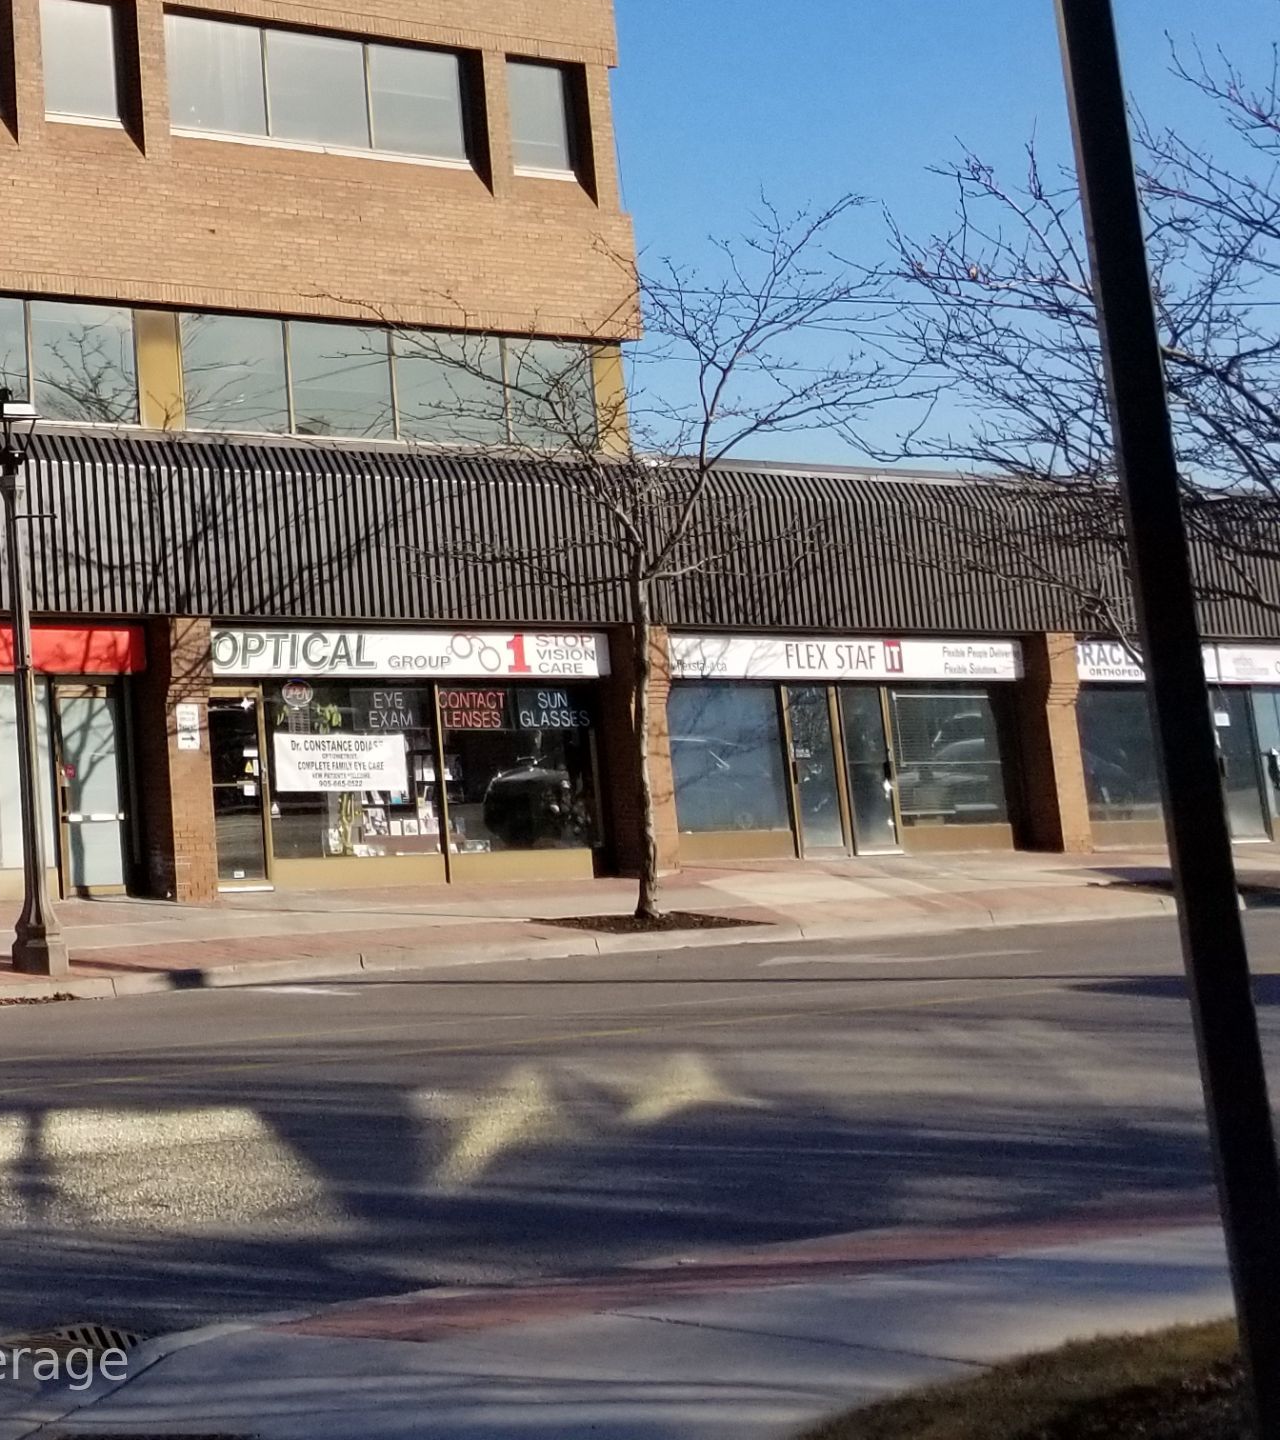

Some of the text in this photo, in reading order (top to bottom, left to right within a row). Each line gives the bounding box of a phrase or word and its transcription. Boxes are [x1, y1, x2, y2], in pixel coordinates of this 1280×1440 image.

[536, 634, 593, 647] STOP
[212, 631, 451, 670] OPTICAL GROUP
[506, 634, 532, 672] 1
[536, 649, 596, 661] VISION
[785, 643, 828, 670] FLEX
[835, 644, 876, 670] STAF
[538, 663, 584, 674] CARE
[1089, 668, 1144, 678] ORTHOPEDI
[373, 692, 405, 710] EYE
[439, 692, 505, 709] CONTACT
[538, 692, 568, 708] SUN
[368, 710, 414, 728] EXAM
[443, 712, 502, 728] LENSES
[519, 711, 591, 728] GLASSES
[291, 740, 302, 751] Dr.
[304, 740, 352, 752] CONSTANCE
[354, 761, 367, 770] EYE
